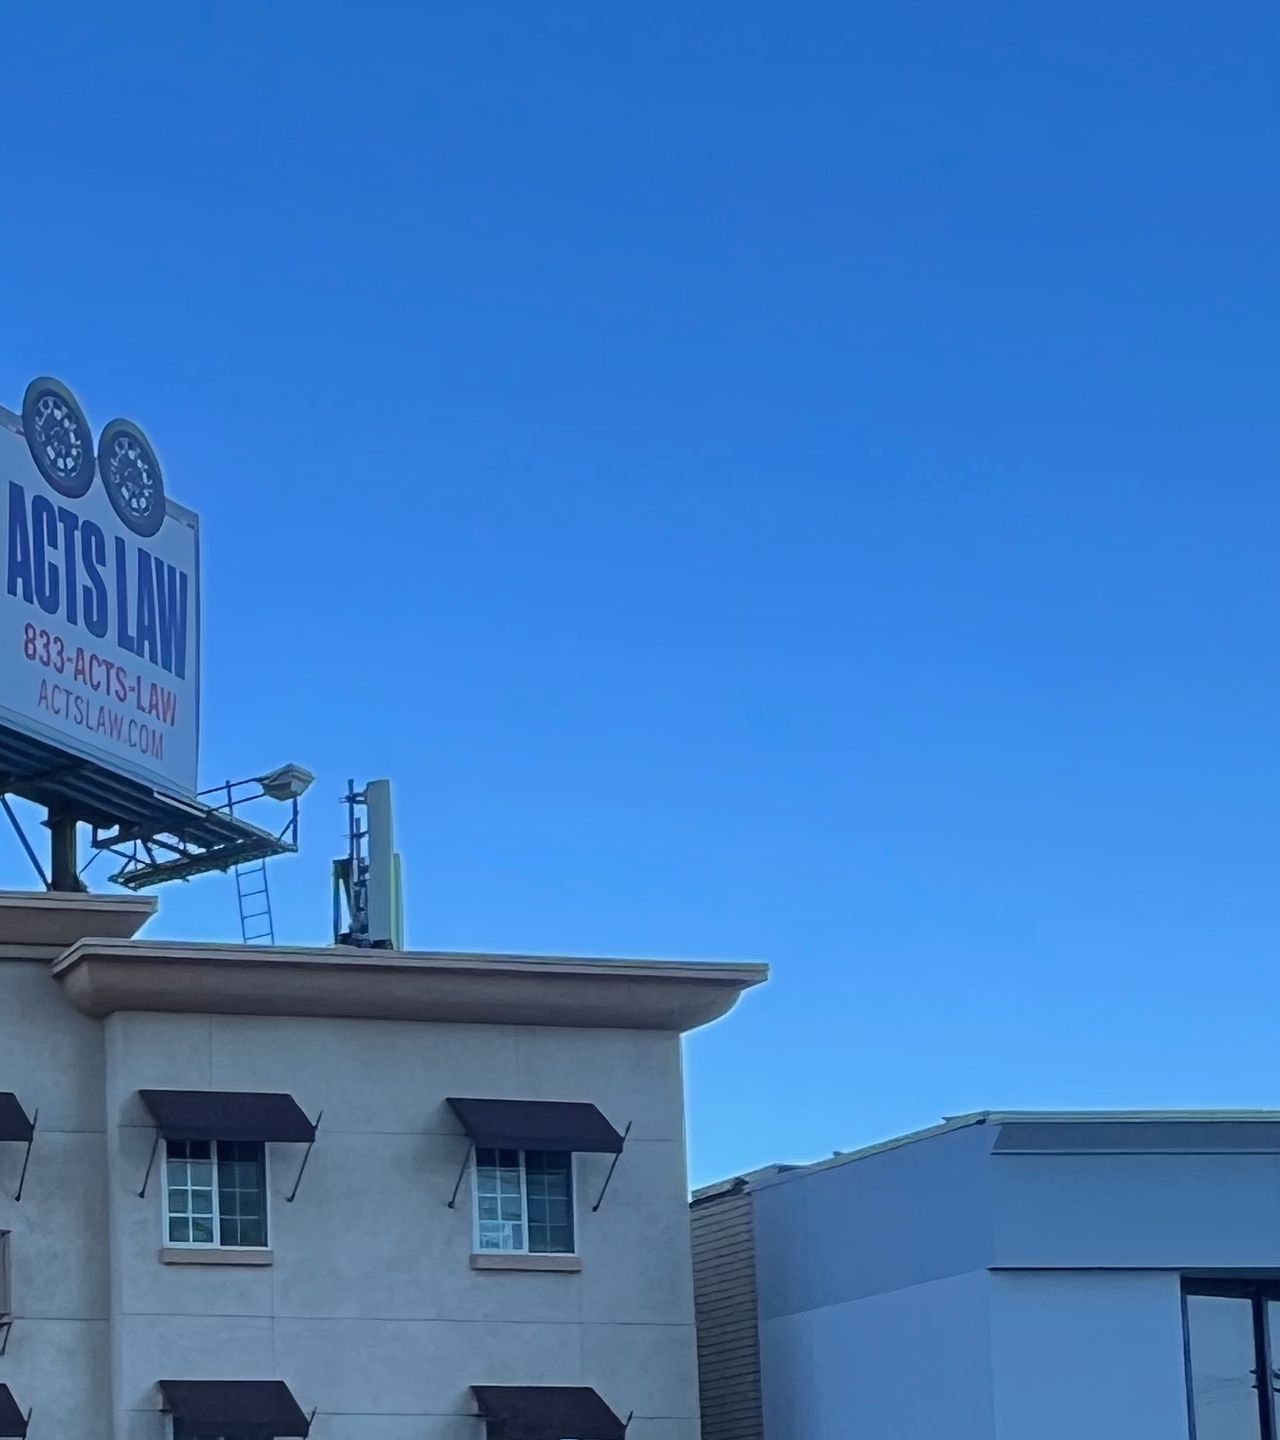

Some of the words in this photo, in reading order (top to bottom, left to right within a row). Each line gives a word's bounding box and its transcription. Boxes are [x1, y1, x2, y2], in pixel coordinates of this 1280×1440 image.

[7, 480, 108, 638] ACTS
[115, 535, 188, 681] LAW
[24, 622, 177, 727] 833-ACTS-LAW
[37, 678, 164, 761] ACTSLAW.COM
